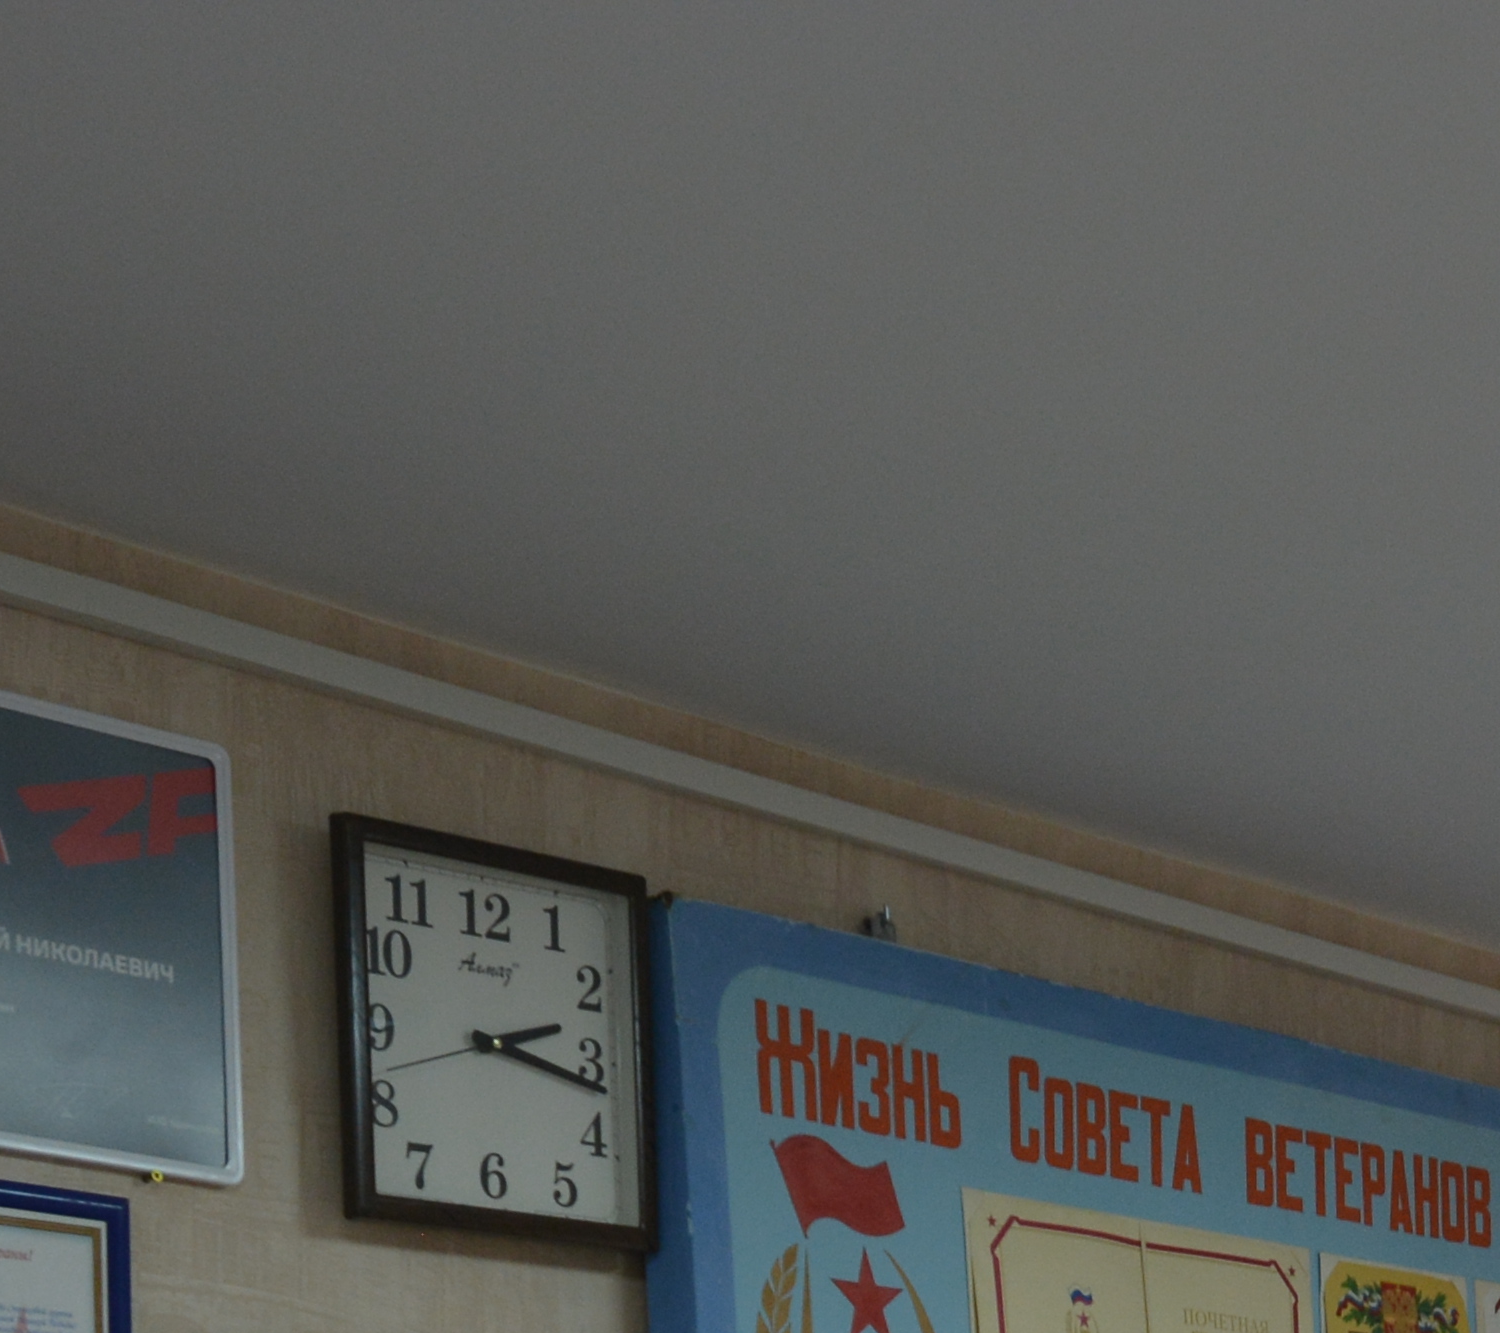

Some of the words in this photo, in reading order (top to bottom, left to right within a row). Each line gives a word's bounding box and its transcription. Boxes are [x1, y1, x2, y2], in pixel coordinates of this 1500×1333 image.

[385, 874, 433, 929] 11
[458, 889, 511, 942] 12
[542, 906, 565, 952] 1
[15, 933, 175, 984] НИКОЛАЕВИЧ
[367, 928, 412, 979] 10
[576, 965, 601, 1013] 2
[369, 1003, 394, 1051] 9
[578, 1038, 602, 1086] 3
[371, 1079, 399, 1127] 8
[580, 1112, 607, 1158] 4
[406, 1142, 433, 1189] 7
[480, 1152, 507, 1199] 6
[553, 1161, 577, 1207] 5
